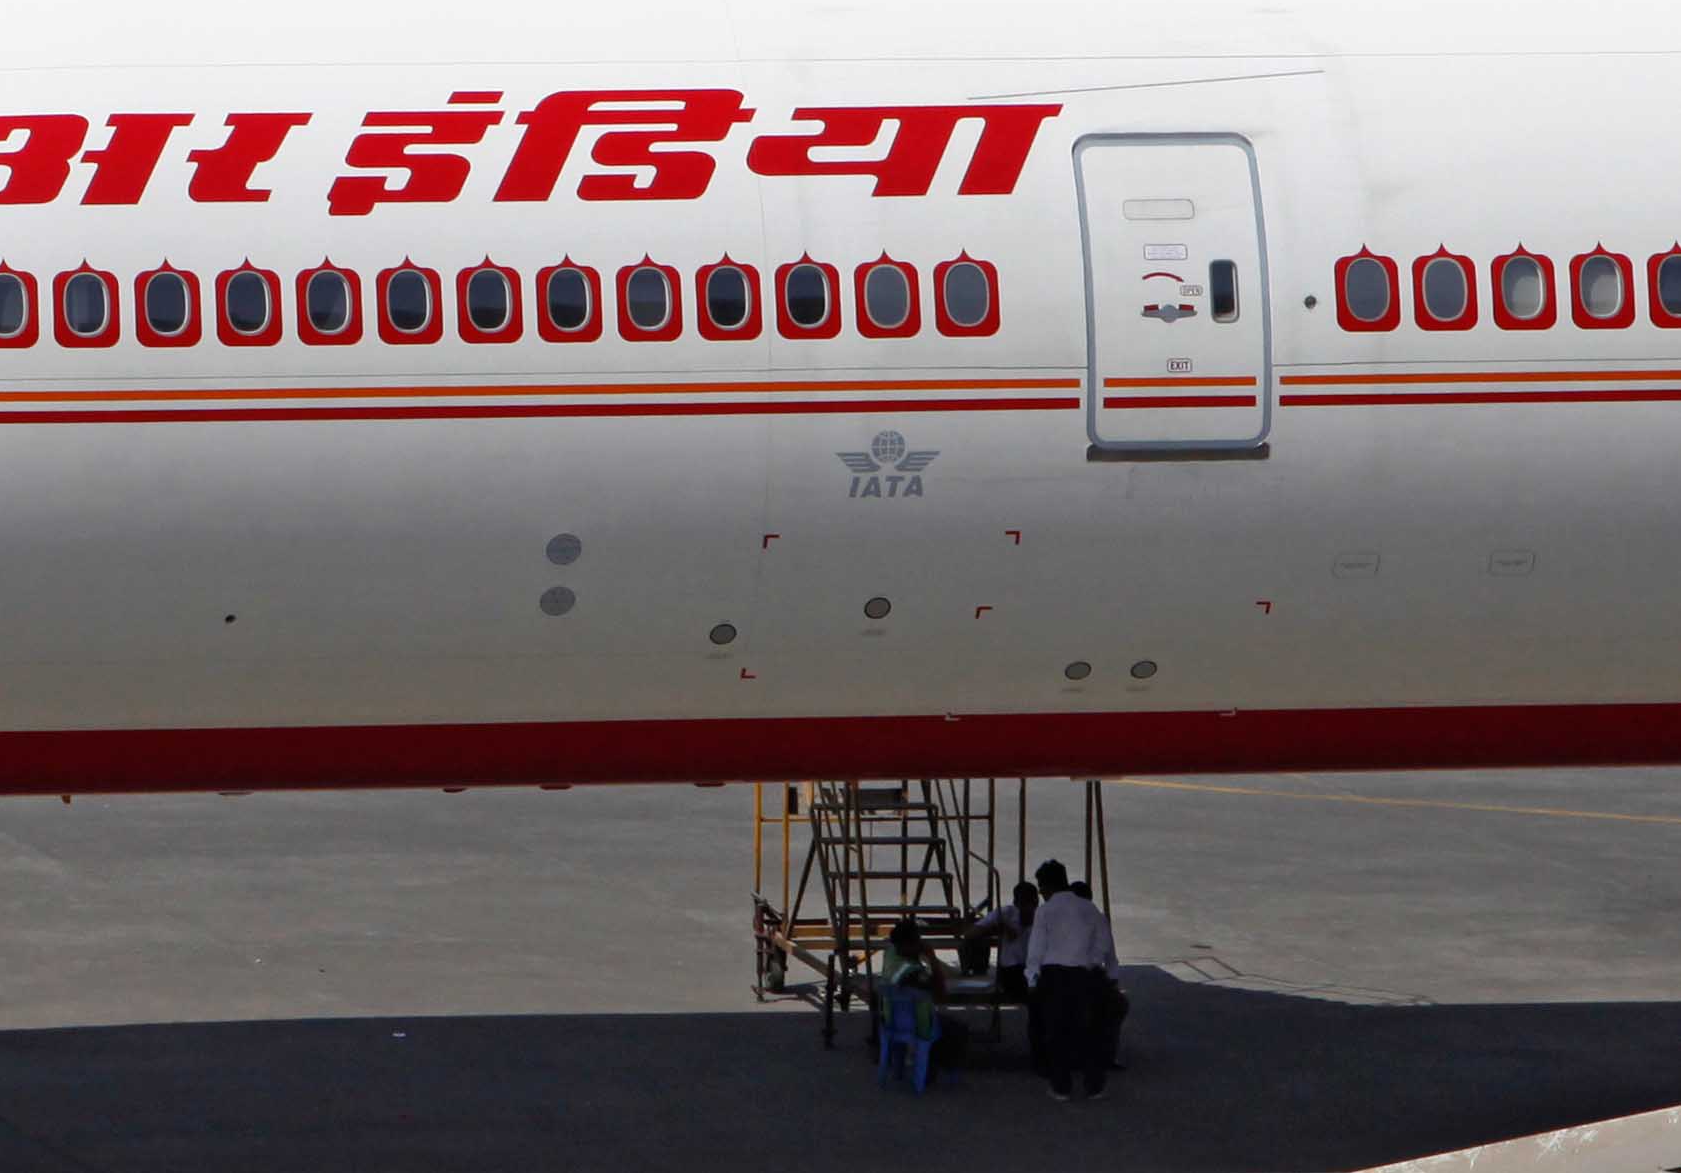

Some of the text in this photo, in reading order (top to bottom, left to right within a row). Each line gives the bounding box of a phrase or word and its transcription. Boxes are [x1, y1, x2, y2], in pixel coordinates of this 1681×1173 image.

[329, 90, 1062, 216] इंडिया
[1171, 361, 1189, 371] EXIT
[848, 475, 924, 498] IATA
